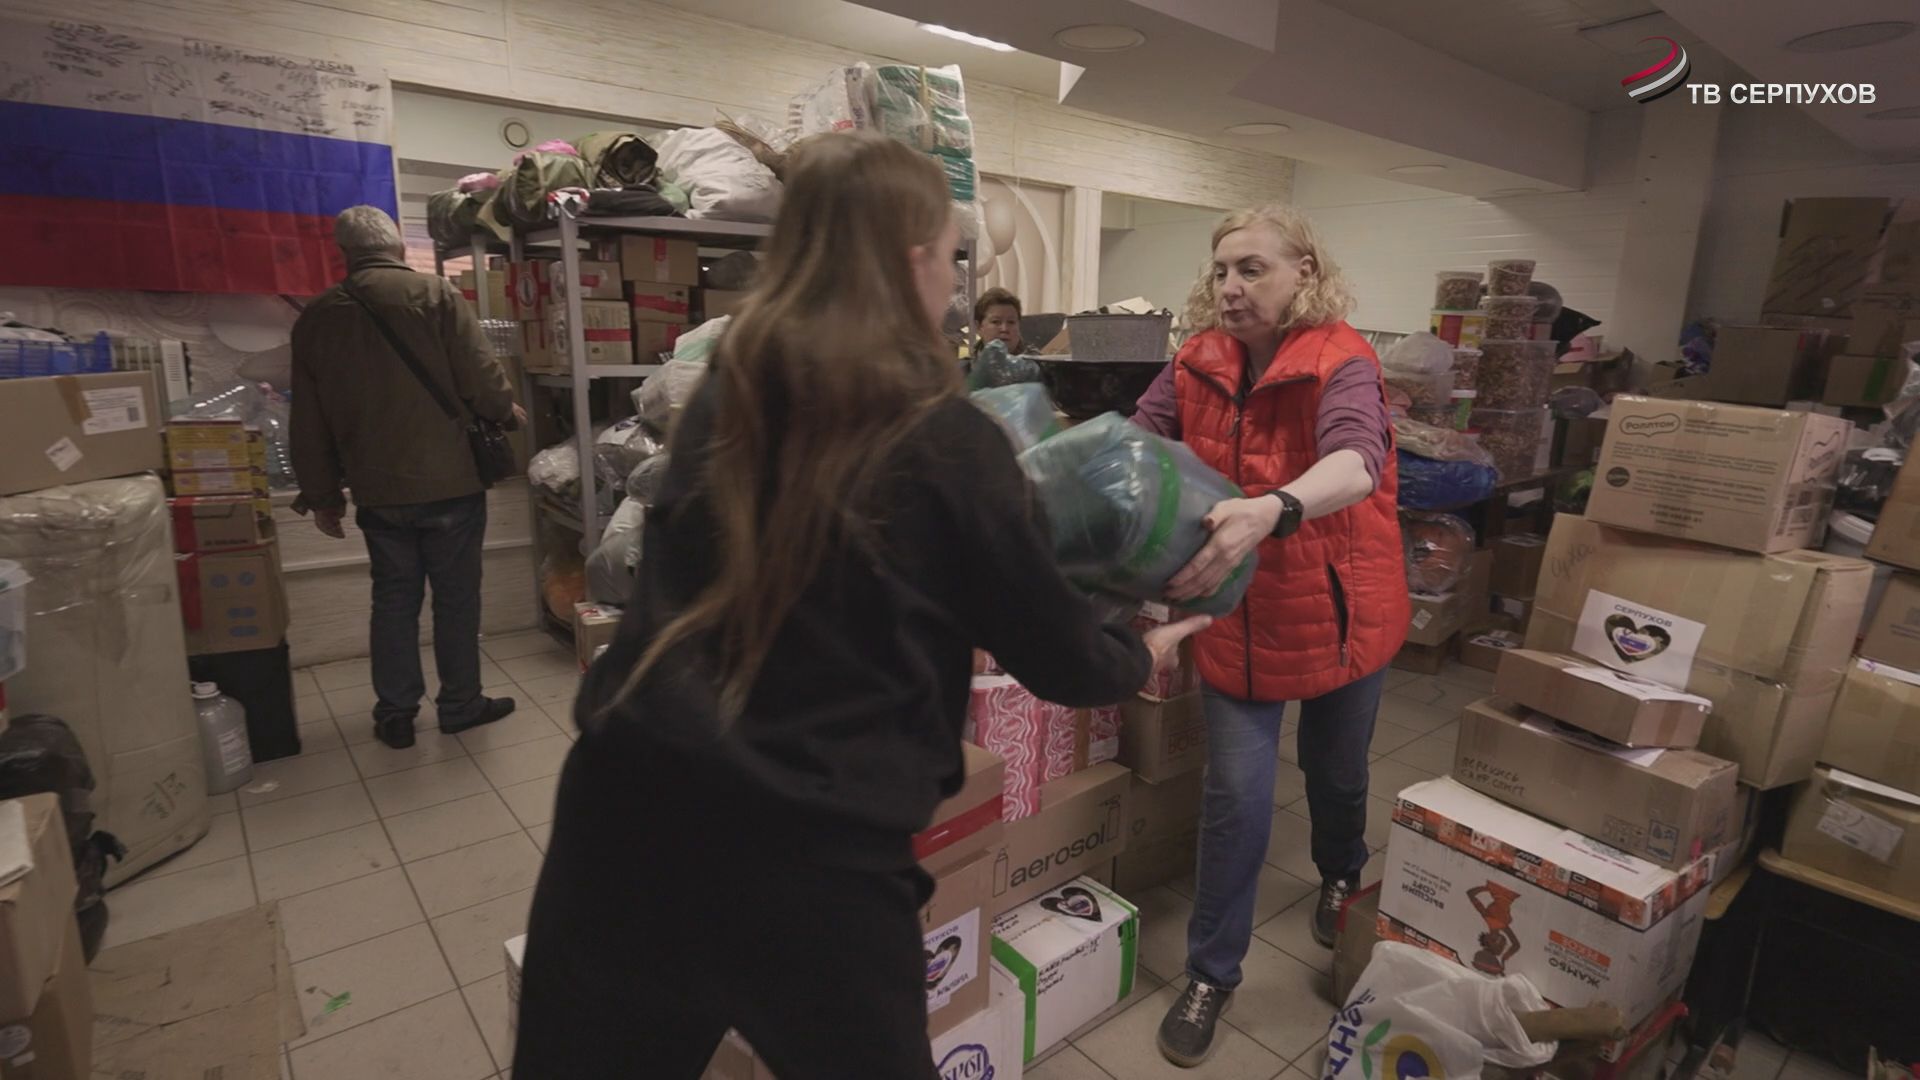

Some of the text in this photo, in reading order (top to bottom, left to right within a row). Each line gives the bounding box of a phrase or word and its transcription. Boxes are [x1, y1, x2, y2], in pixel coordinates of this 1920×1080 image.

[1614, 604, 1672, 627] СЕРПУХОВ
[1010, 824, 1105, 888] aerosol
[1549, 957, 1600, 989] ЖАМБО
